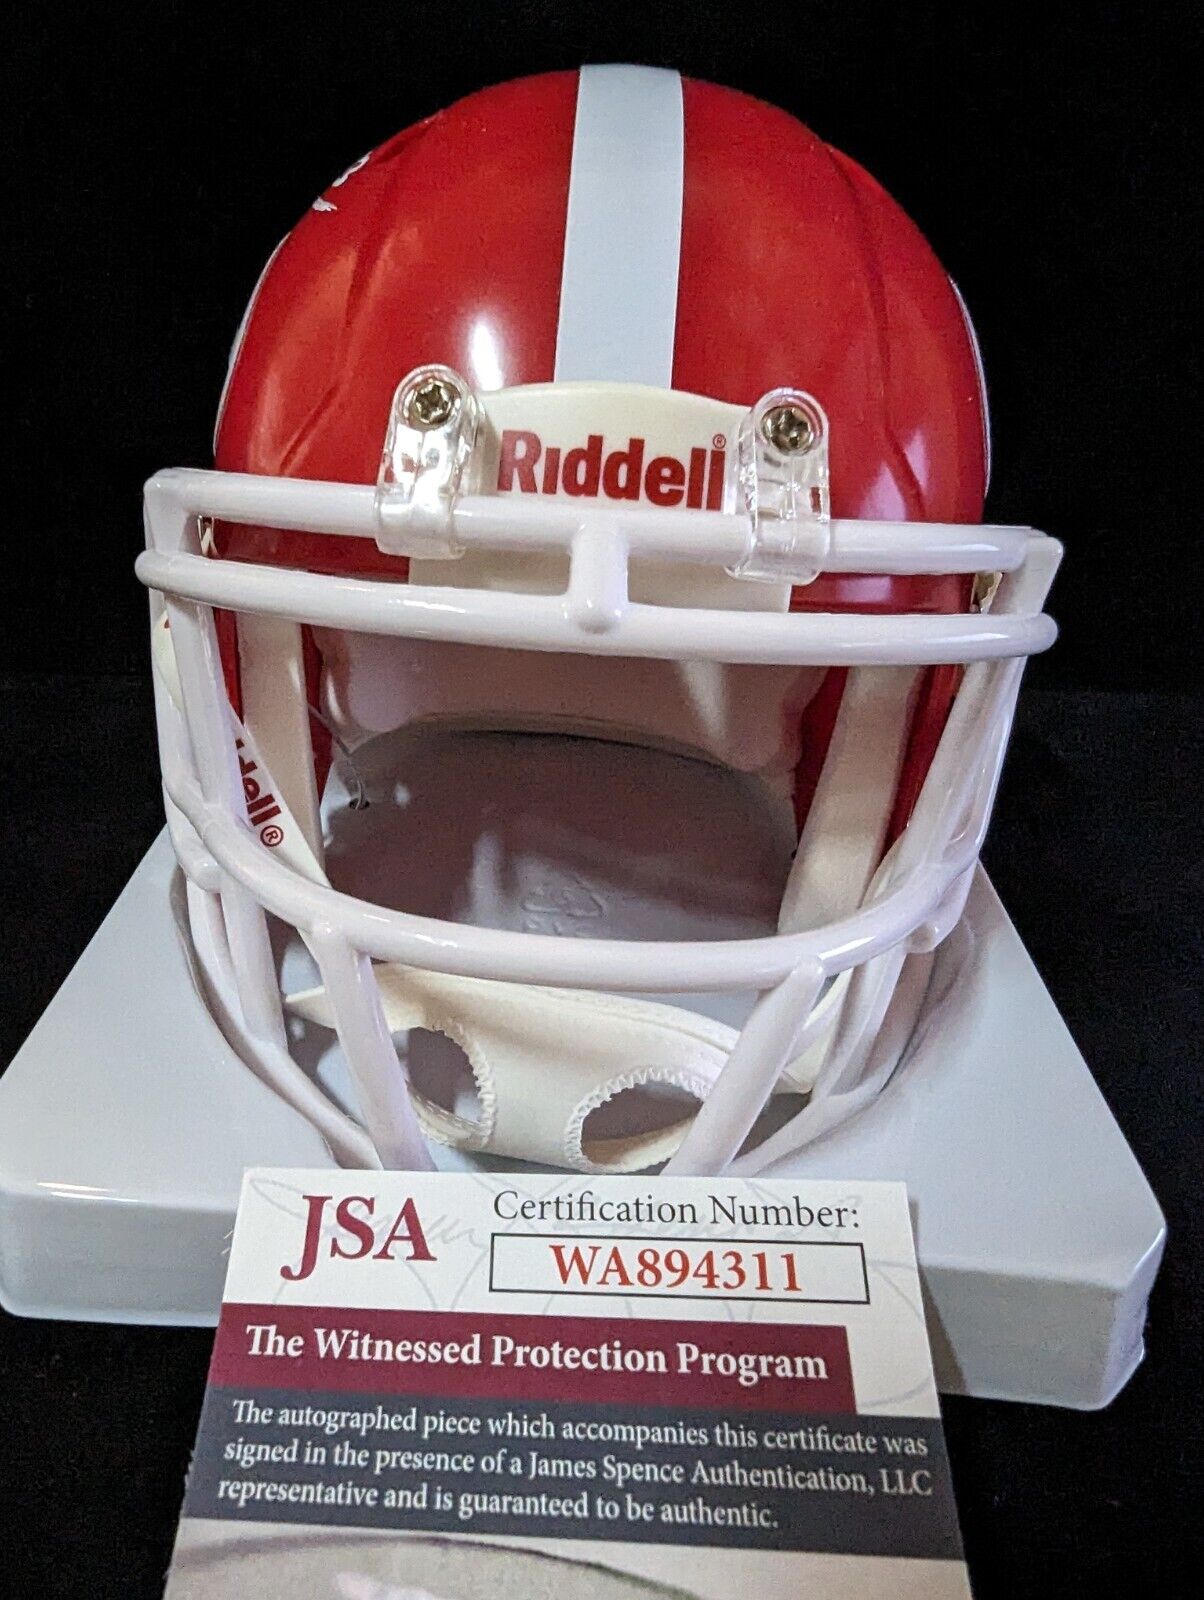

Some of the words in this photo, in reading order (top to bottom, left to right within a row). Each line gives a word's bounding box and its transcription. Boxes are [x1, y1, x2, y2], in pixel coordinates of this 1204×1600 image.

[279, 1194, 438, 1281] JSA
[493, 1190, 699, 1224] Certification
[707, 1195, 859, 1228] Number:
[548, 1244, 802, 1292] WA894311
[246, 1324, 305, 1357] The
[313, 1328, 482, 1365] Witnessed
[490, 1335, 668, 1373] Protection
[675, 1342, 828, 1387] Program
[232, 1399, 274, 1425] The
[277, 1405, 417, 1437] autographed
[421, 1410, 482, 1440] piece
[486, 1411, 556, 1439] which
[561, 1421, 709, 1451] accompanies
[714, 1421, 758, 1448] this
[762, 1425, 878, 1454] certificate
[882, 1436, 929, 1456] was
[223, 1437, 299, 1469] signed
[303, 1440, 327, 1465] in
[333, 1440, 370, 1468] the
[373, 1449, 475, 1475] presence
[480, 1447, 508, 1474] of
[509, 1457, 523, 1475] a
[529, 1451, 597, 1480] James
[602, 1454, 685, 1489] Spence
[690, 1459, 875, 1495] Authentication,
[878, 1468, 933, 1496] LLC
[217, 1479, 379, 1508] representative
[383, 1482, 428, 1510] and
[434, 1485, 453, 1511] is
[458, 1491, 589, 1520] guaranteed
[595, 1496, 621, 1520] to
[625, 1493, 655, 1522] be
[660, 1497, 778, 1528] authentic.
